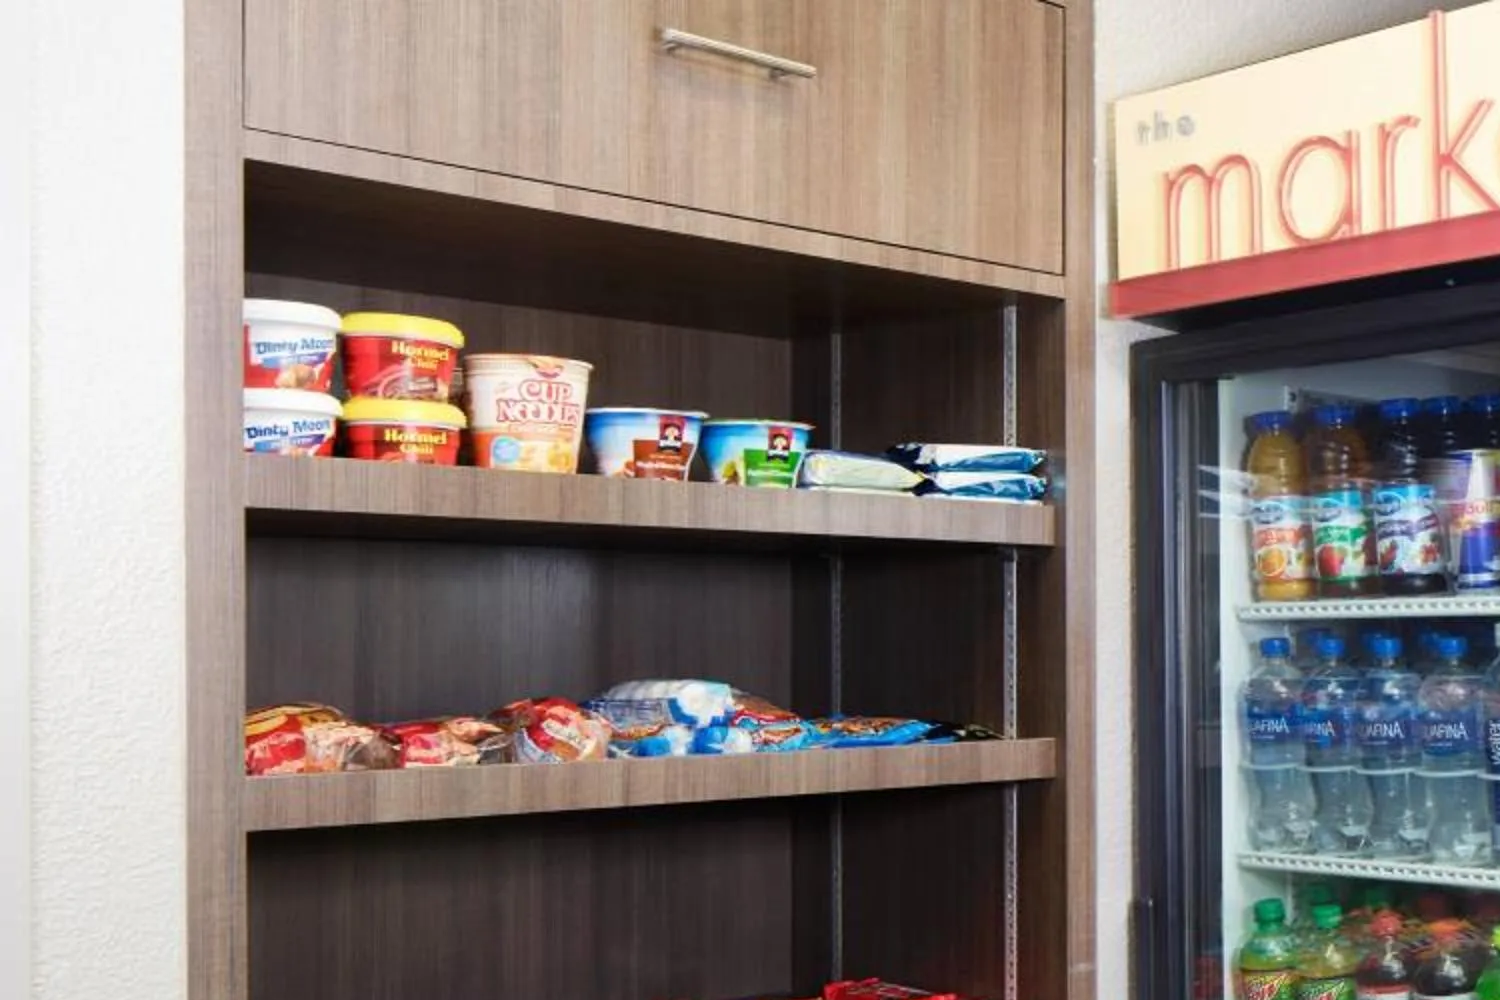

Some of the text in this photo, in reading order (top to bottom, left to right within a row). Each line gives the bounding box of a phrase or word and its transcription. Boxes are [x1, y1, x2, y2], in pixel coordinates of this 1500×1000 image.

[1136, 111, 1195, 145] the
[391, 340, 449, 360] Hormel
[519, 380, 573, 402] CUP
[496, 399, 580, 426] NOODLES
[245, 425, 288, 439] Dinty
[384, 427, 447, 444] Hormel
